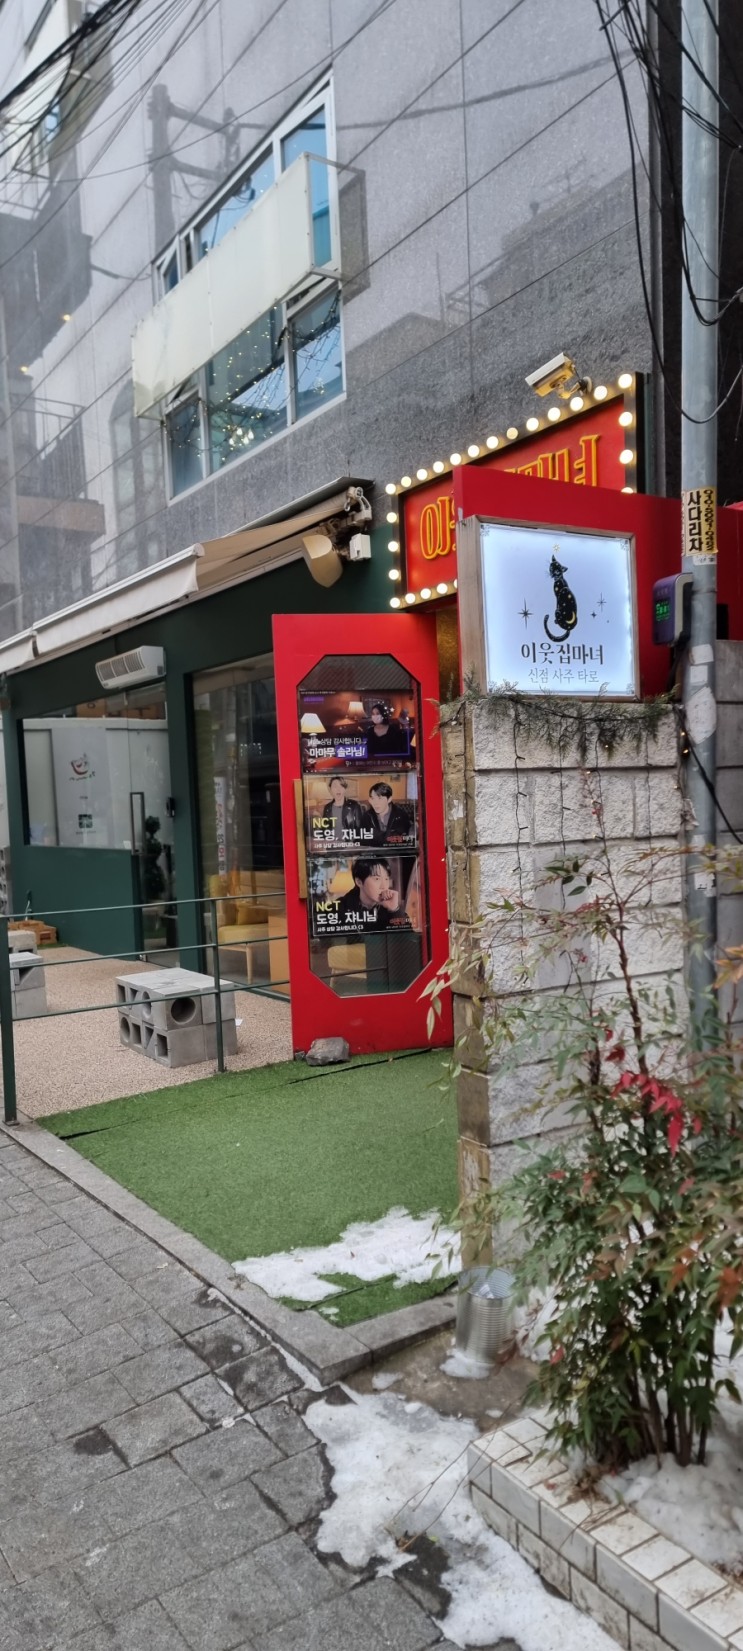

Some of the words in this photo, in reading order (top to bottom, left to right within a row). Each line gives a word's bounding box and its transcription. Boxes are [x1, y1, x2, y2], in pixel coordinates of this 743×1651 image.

[688, 490, 703, 551] 사다리차
[521, 641, 604, 665] 이웃집마녀
[528, 668, 549, 684] 신점
[552, 668, 575, 684] 사주
[578, 669, 600, 684] 타로
[309, 747, 336, 758] 마마무
[336, 746, 365, 757] 솔라님!
[312, 817, 338, 828] NCT
[313, 829, 339, 841] 도영,
[341, 828, 374, 840] 쟈니님
[316, 900, 341, 912] NCT
[316, 913, 342, 925] 도영,
[345, 910, 377, 923] 쟈니님
